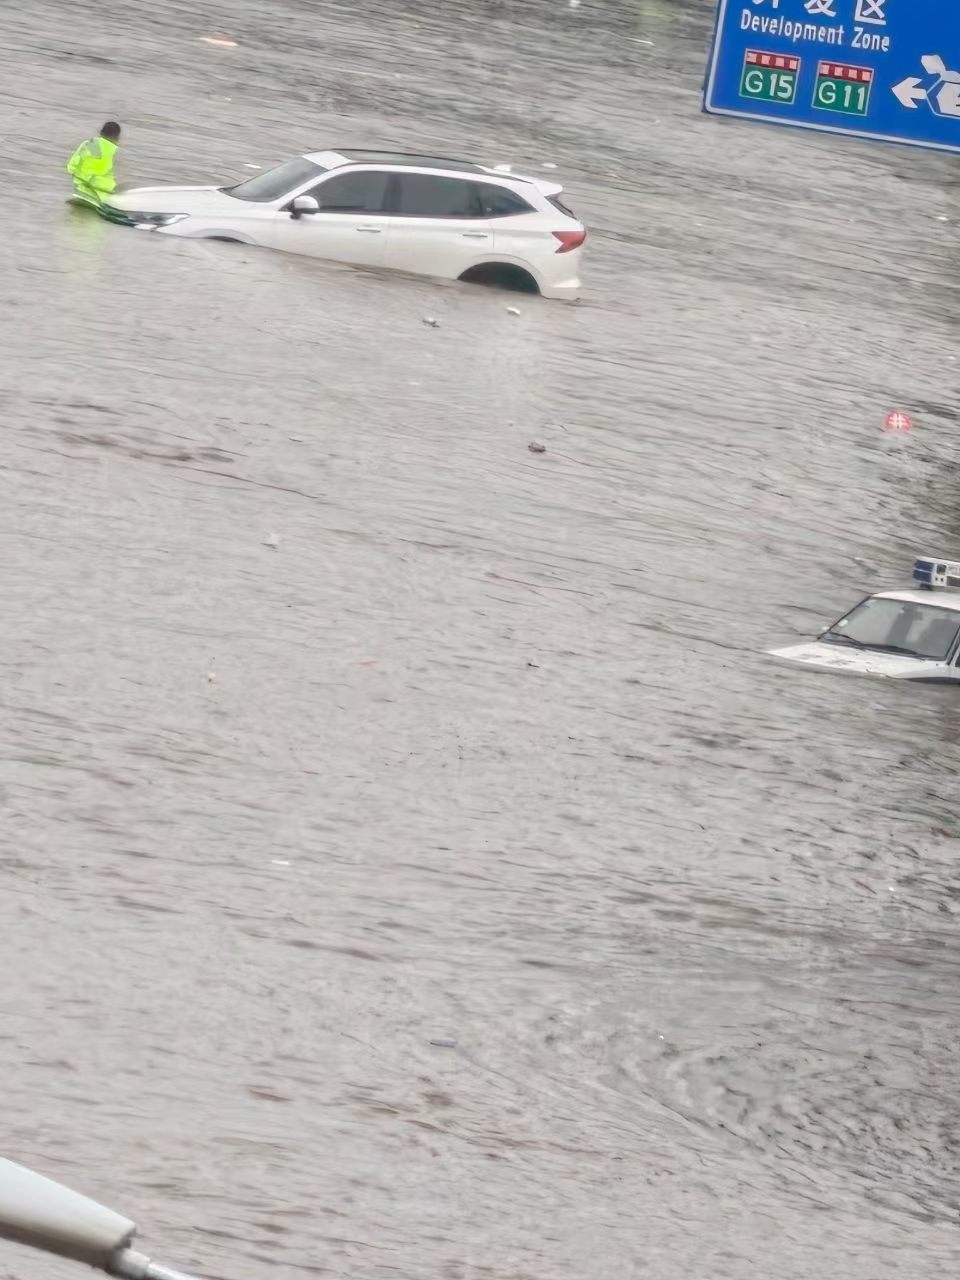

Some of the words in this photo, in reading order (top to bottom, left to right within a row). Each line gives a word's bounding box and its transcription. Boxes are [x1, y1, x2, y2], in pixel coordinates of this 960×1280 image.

[740, 8, 845, 46] Development
[851, 26, 890, 53] Zone
[744, 70, 794, 100] G15
[818, 81, 865, 111] G11
